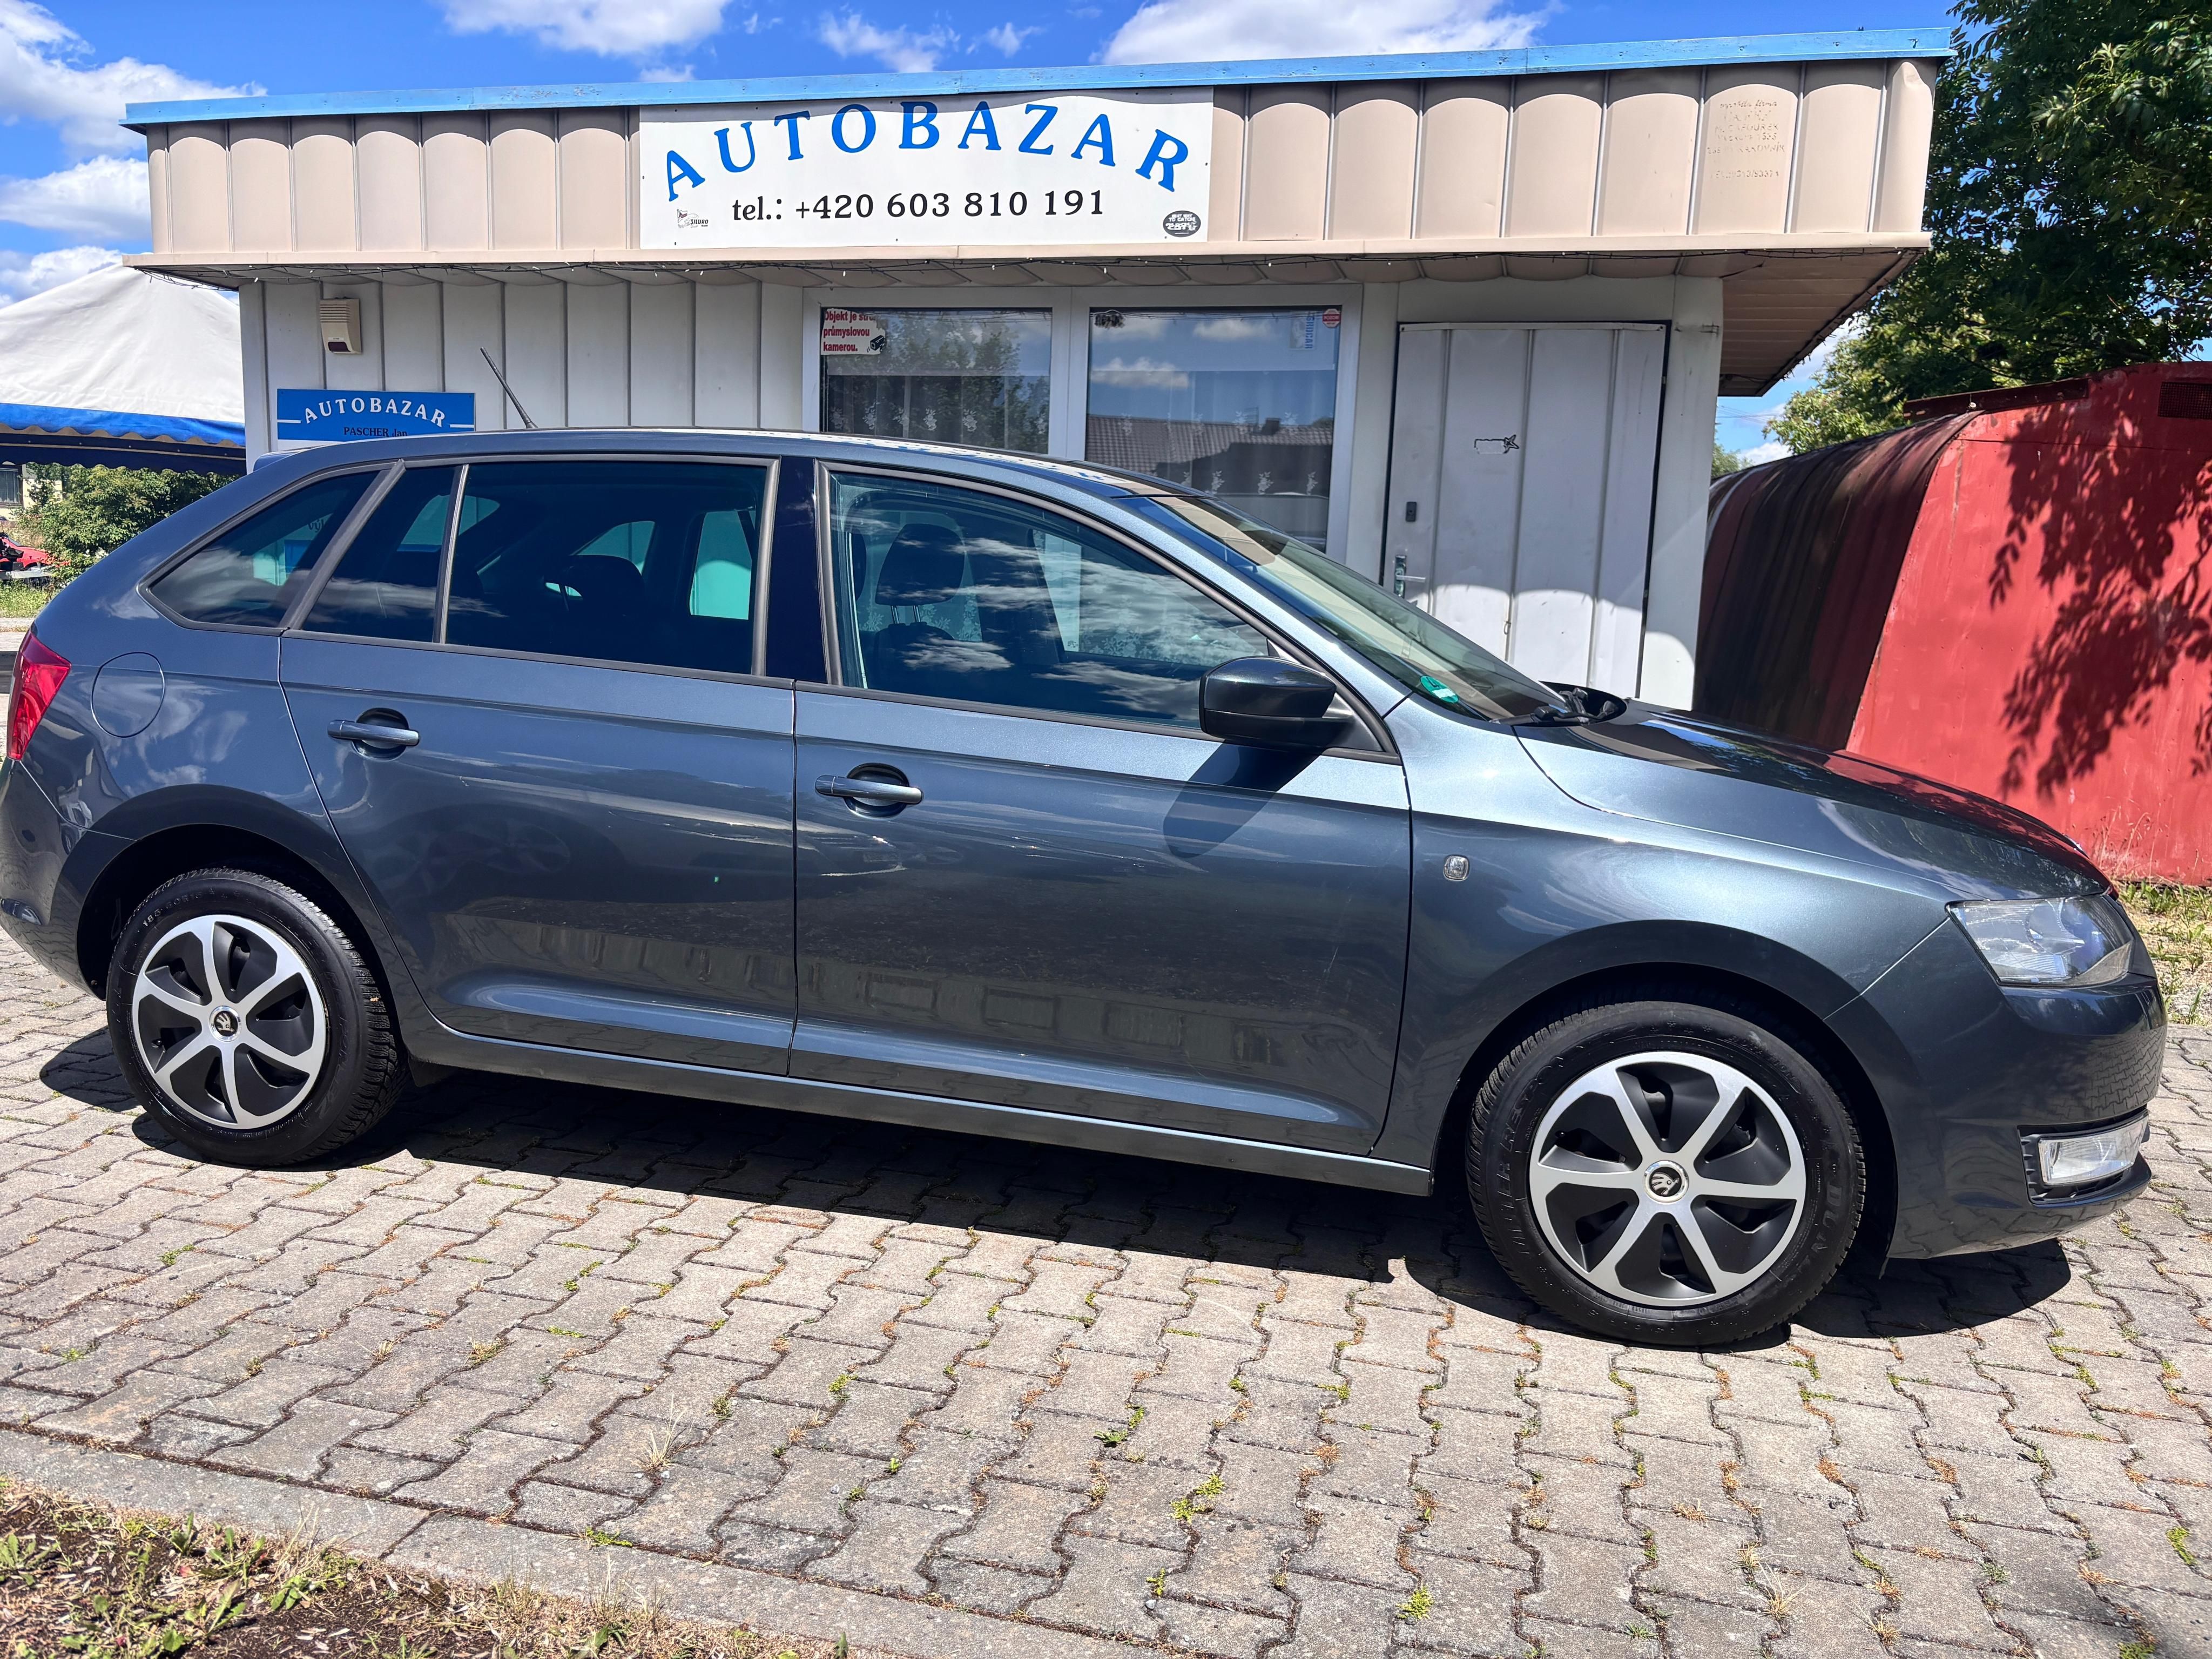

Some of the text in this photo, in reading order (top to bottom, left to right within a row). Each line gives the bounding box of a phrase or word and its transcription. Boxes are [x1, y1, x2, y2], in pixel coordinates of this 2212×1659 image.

[667, 100, 1189, 202] AUTOBAZAR
[732, 190, 1103, 220] tel.: +420 603 810 191
[823, 325, 870, 338] průmyslovou
[823, 341, 858, 352] kamerou.
[305, 397, 446, 428] AUTOBAZAR
[343, 427, 389, 437] PASCHER
